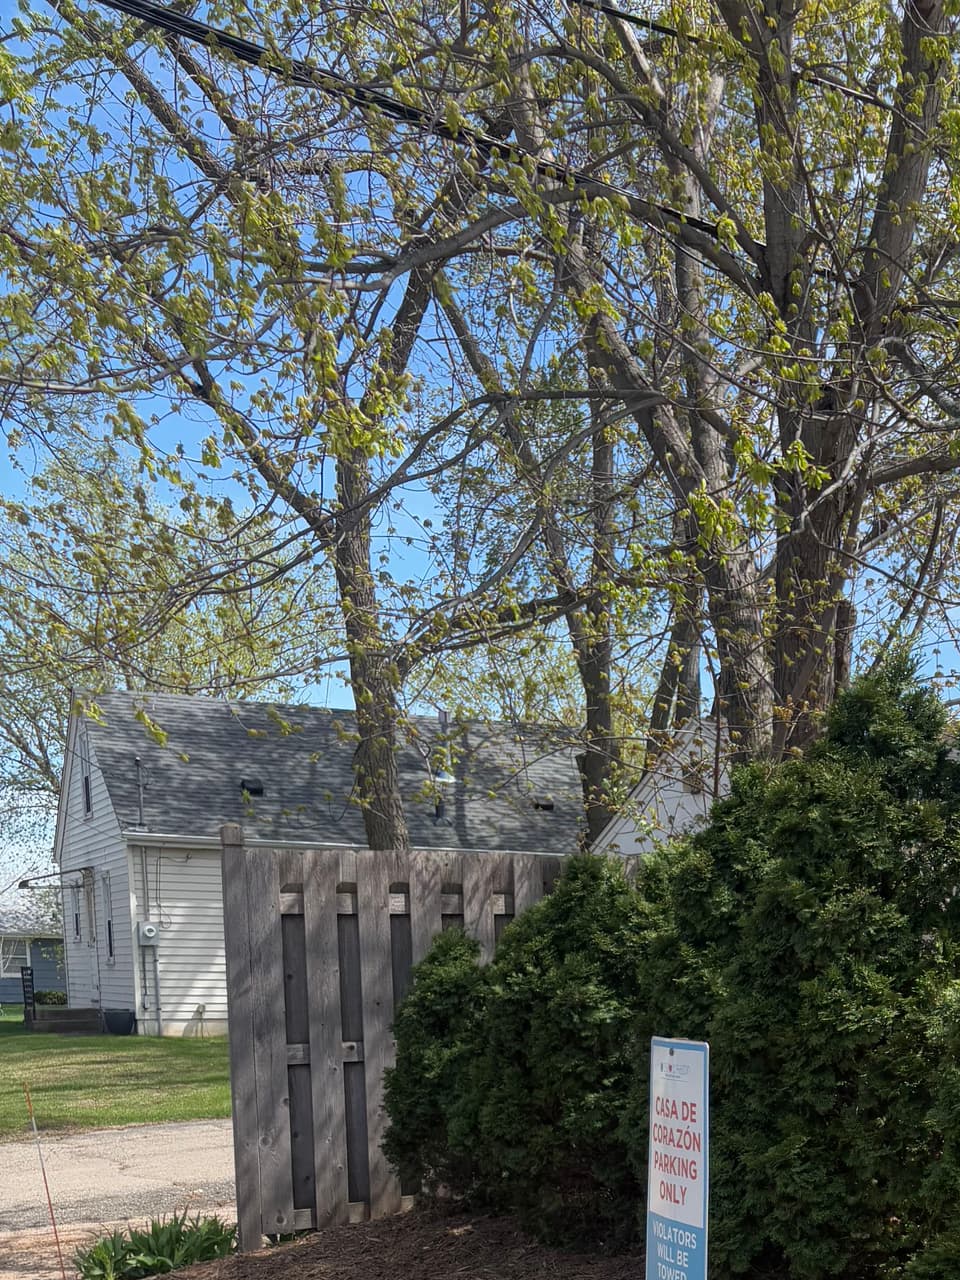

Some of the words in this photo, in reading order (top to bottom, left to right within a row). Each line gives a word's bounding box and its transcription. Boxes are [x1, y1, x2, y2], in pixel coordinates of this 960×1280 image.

[656, 1096, 678, 1119] CASA
[681, 1102, 696, 1123] DE
[653, 1123, 701, 1152] CORAZÓN
[654, 1151, 697, 1180] PARKING
[660, 1182, 687, 1205] ONLY
[653, 1221, 696, 1249] VIOLATORS
[657, 1243, 674, 1263] WILL
[677, 1250, 688, 1267] BE
